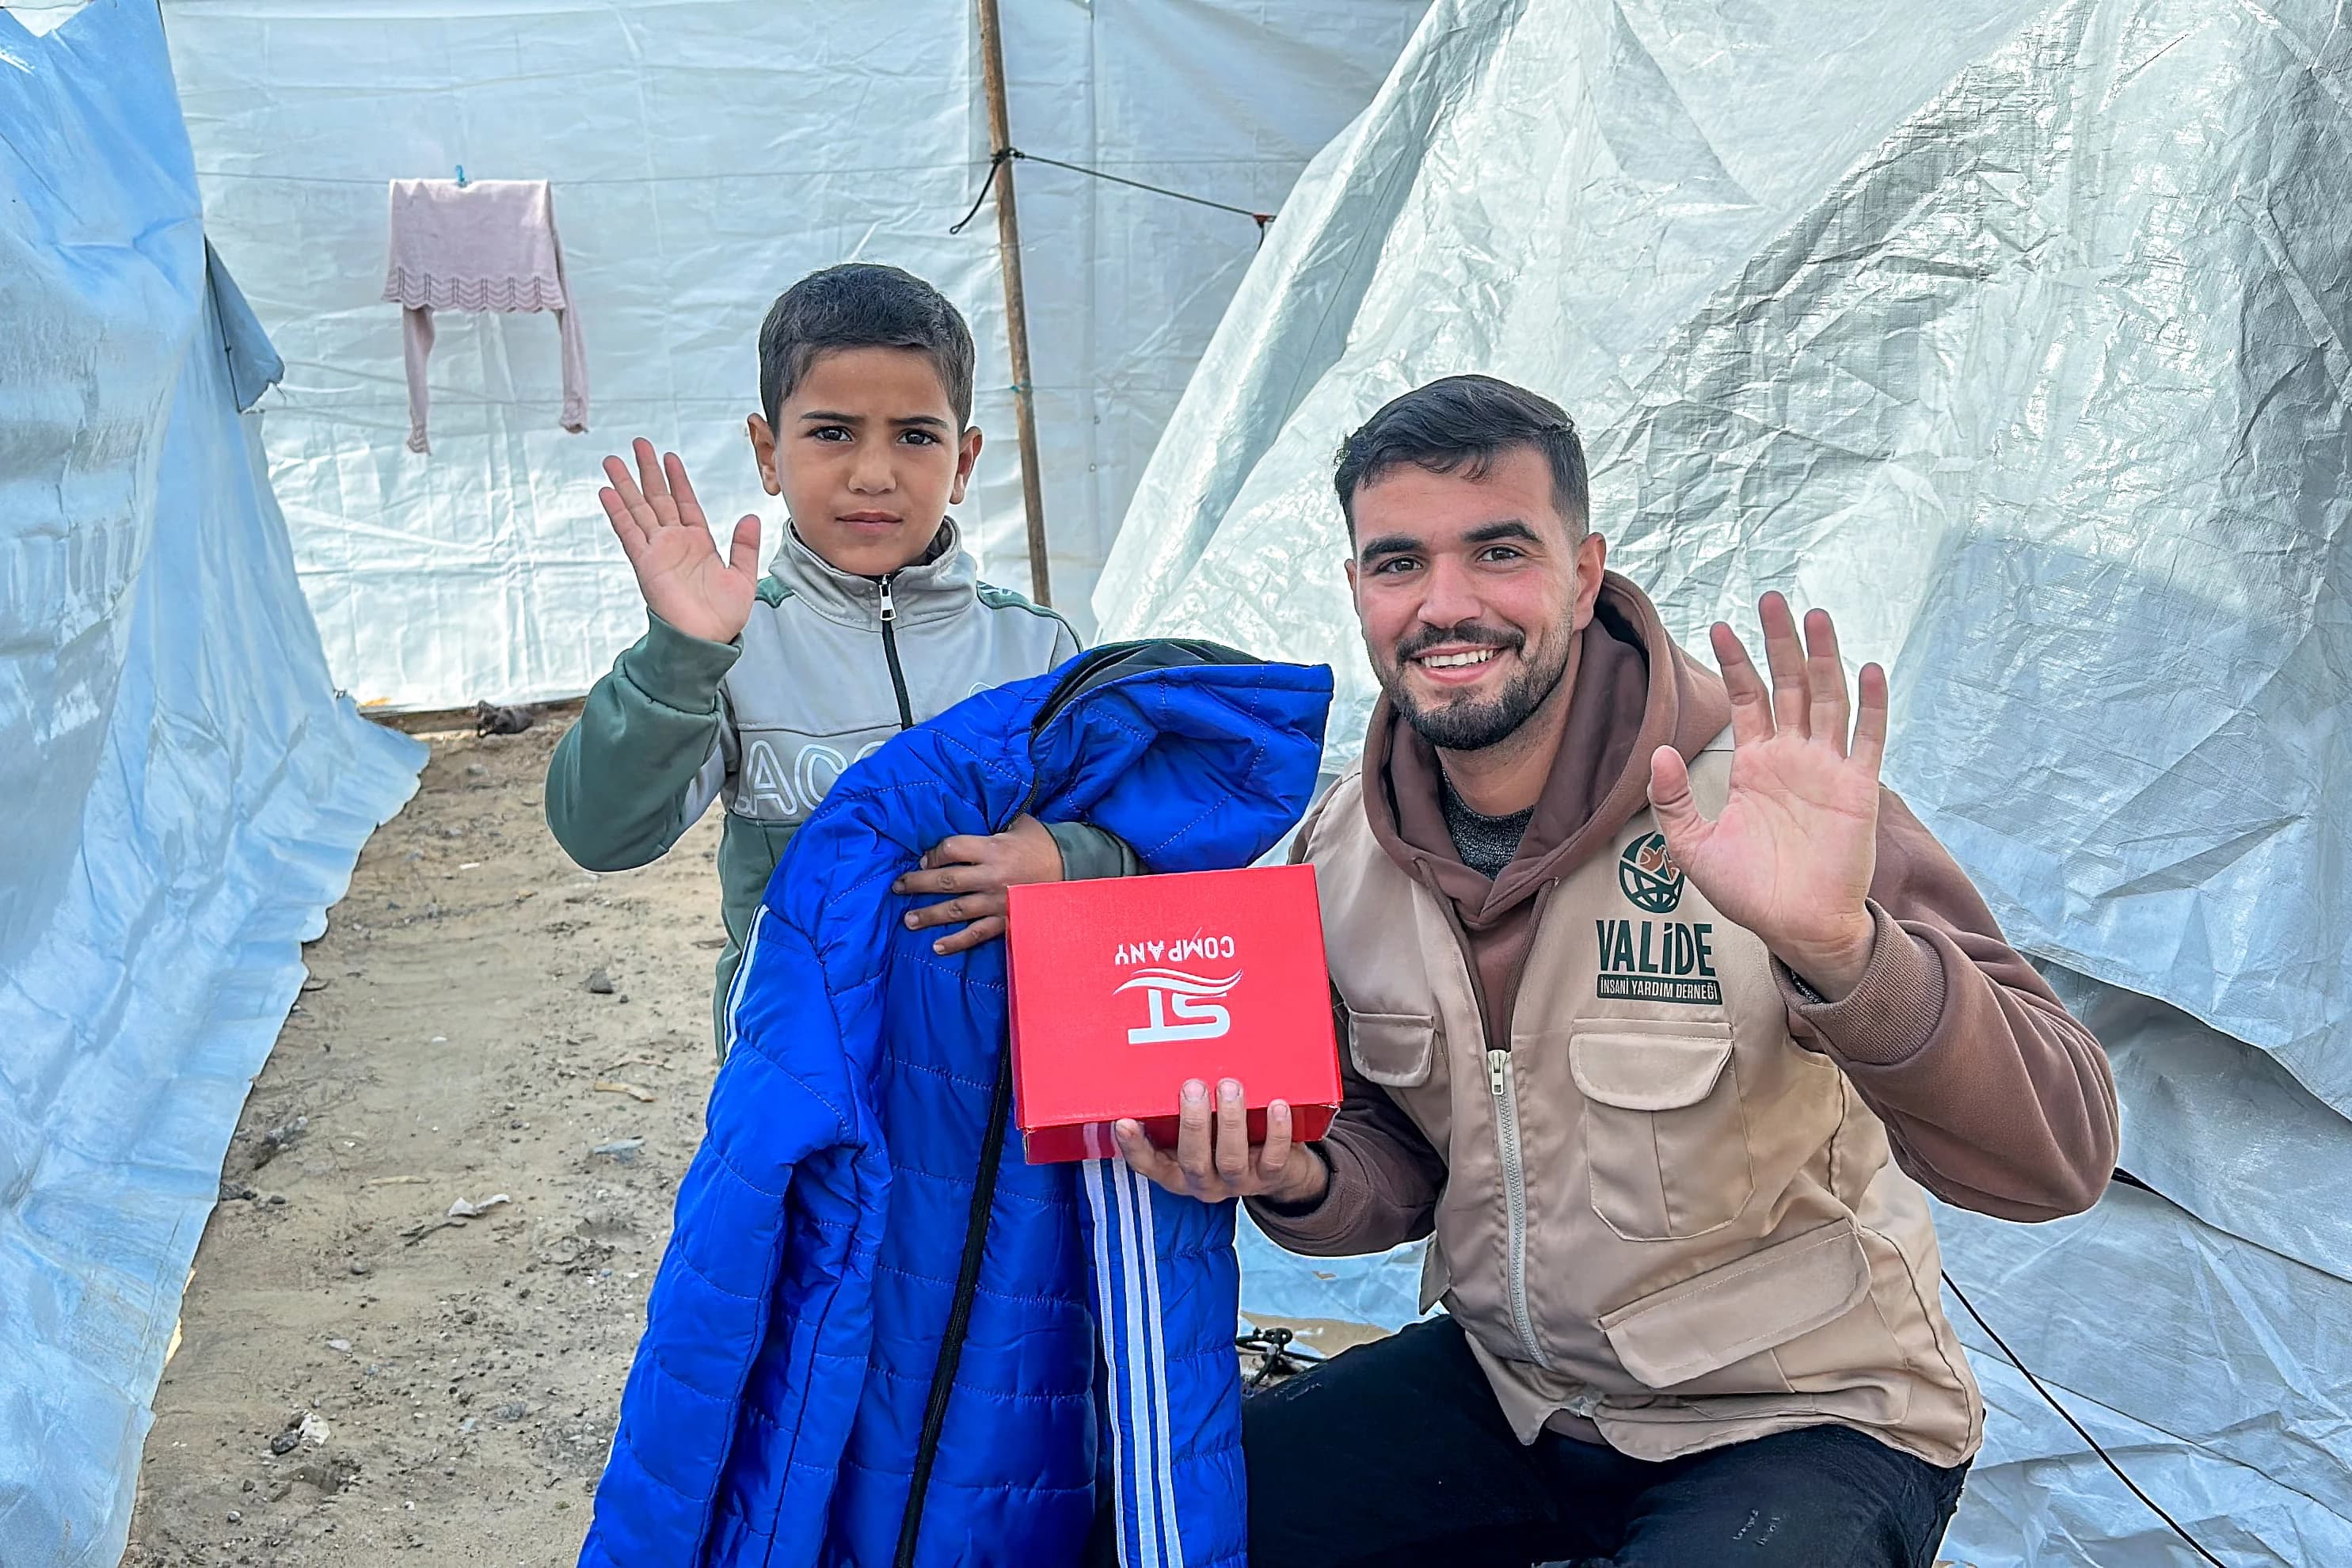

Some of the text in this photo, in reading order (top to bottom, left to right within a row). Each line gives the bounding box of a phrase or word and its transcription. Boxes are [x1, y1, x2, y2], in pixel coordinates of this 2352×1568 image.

[1114, 935, 1235, 965] COMPANY
[1600, 976, 1718, 1000] İNSANİ YARDIM DERNEĞİ
[1128, 989, 1231, 1045] ST
